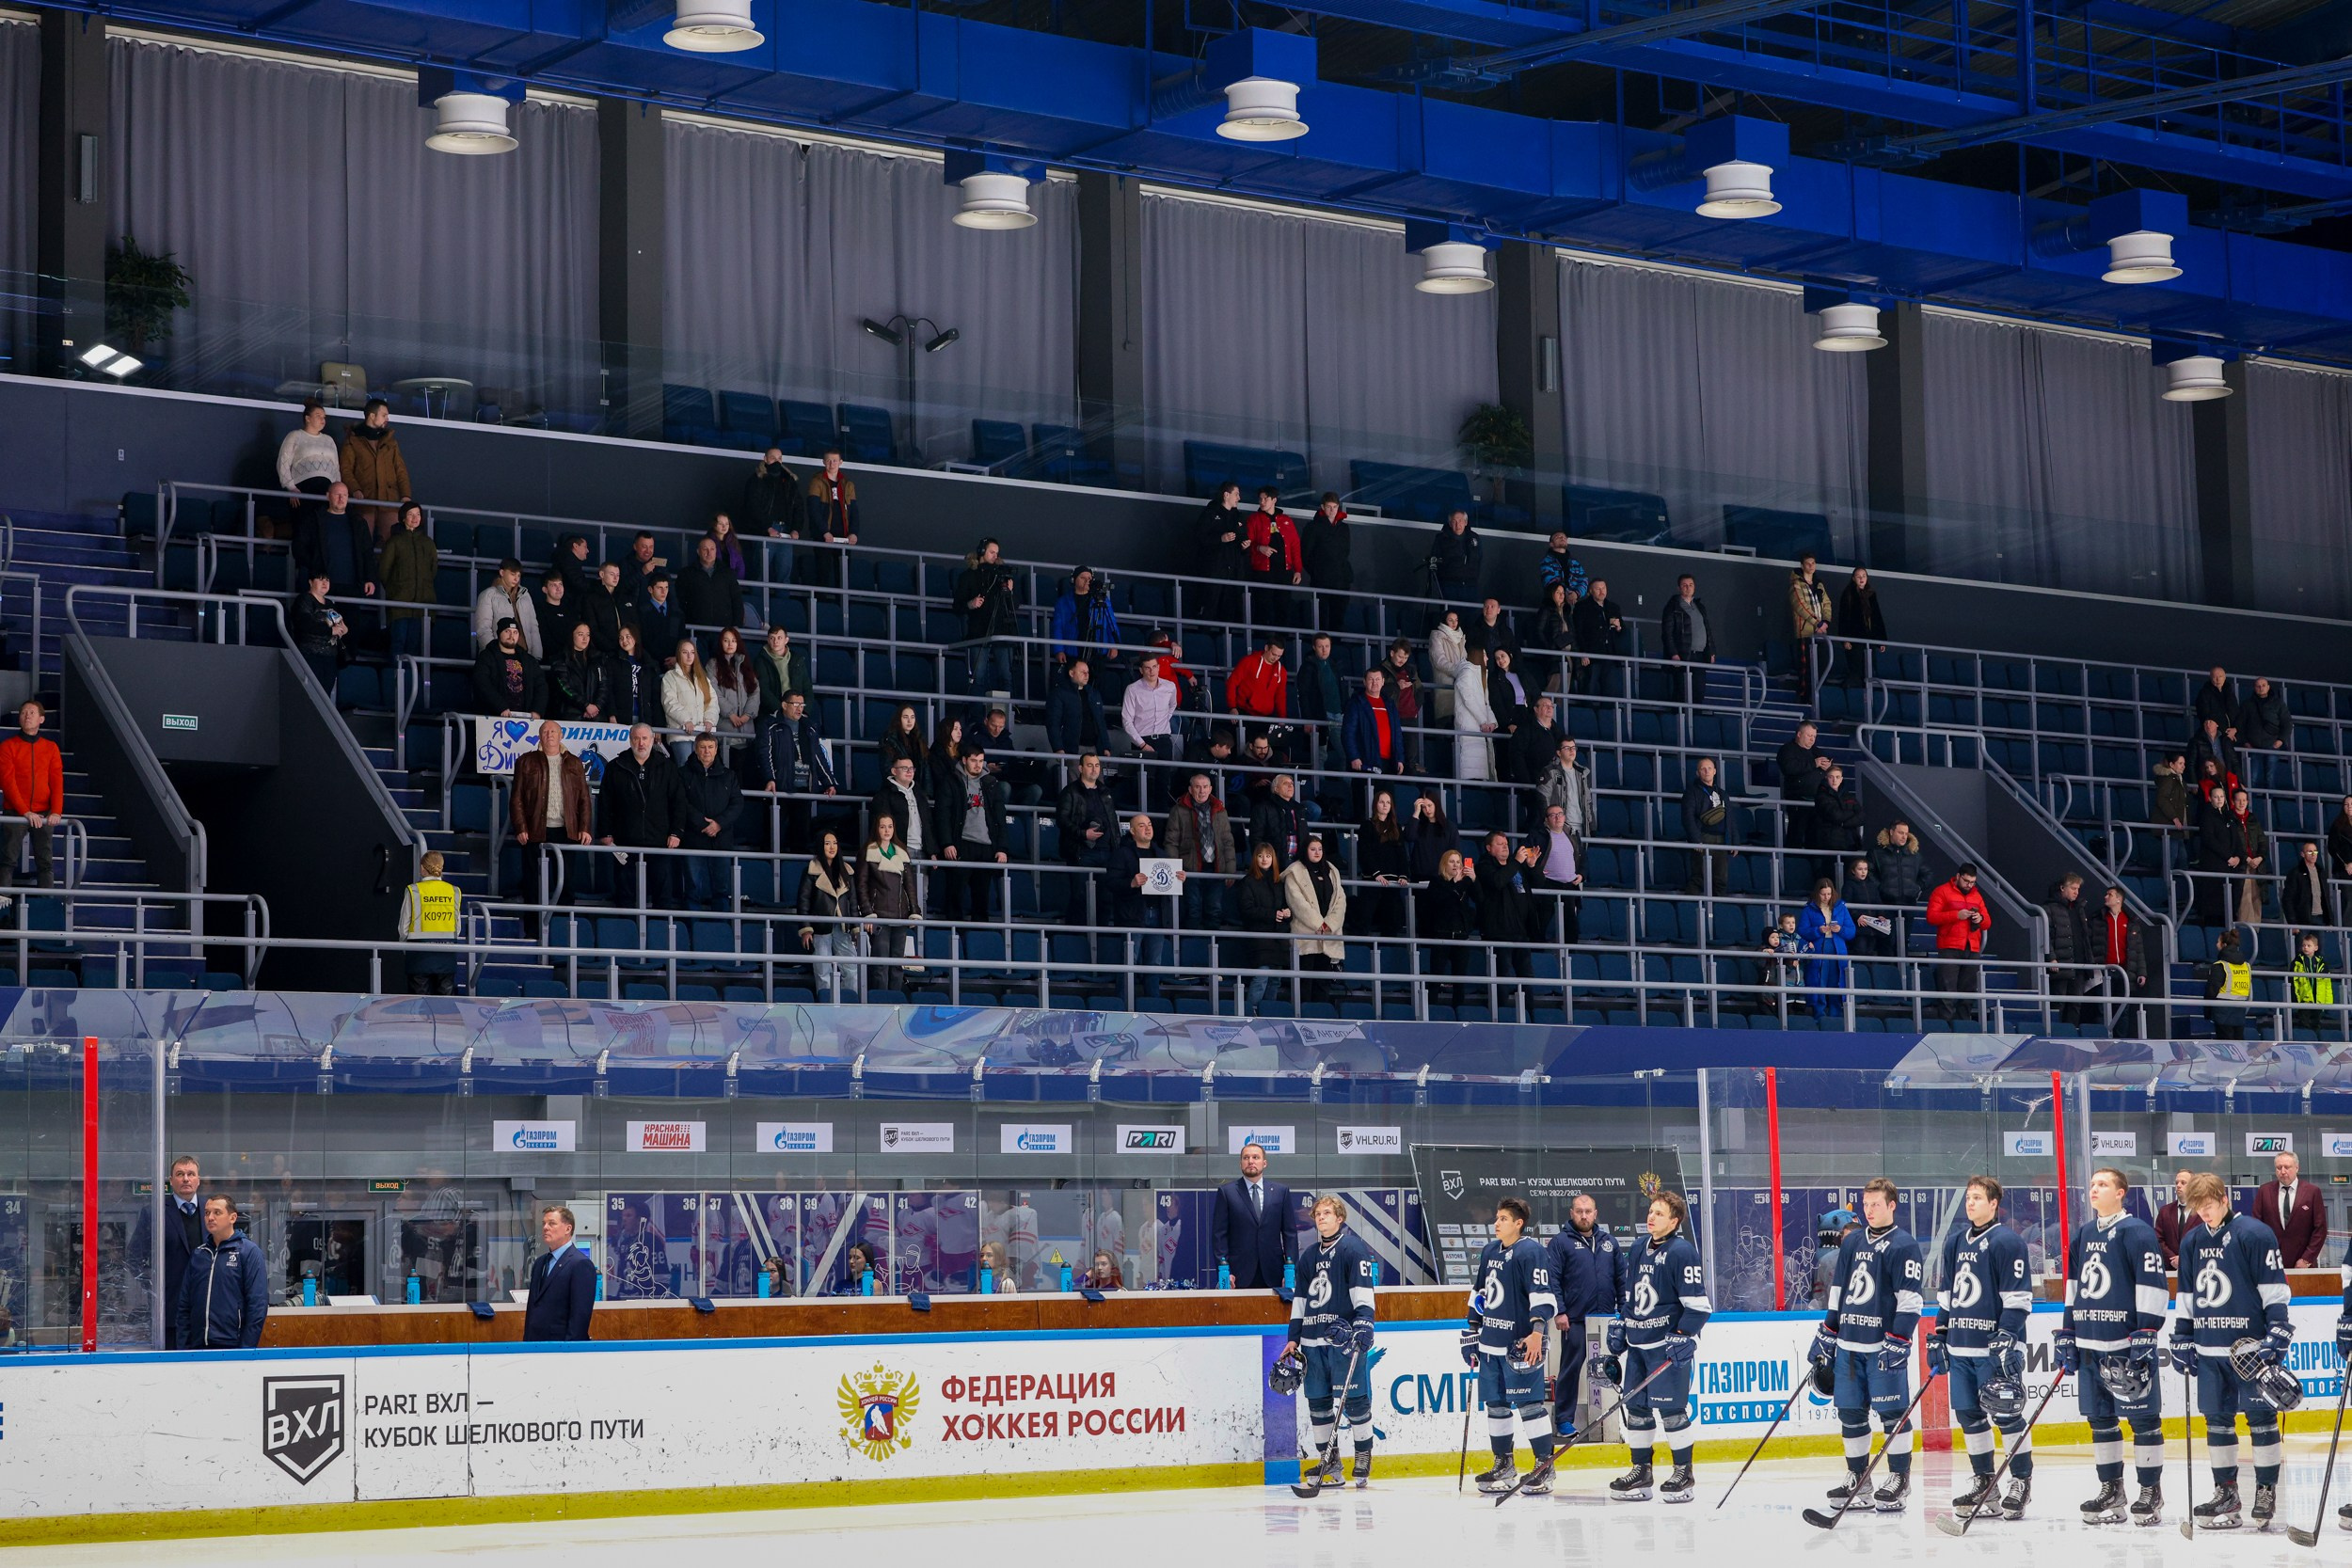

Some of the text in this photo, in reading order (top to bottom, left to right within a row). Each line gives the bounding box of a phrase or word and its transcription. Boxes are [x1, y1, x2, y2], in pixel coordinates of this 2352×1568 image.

[166, 718, 196, 728] ВЫХОД
[492, 721, 503, 739] Я
[424, 911, 453, 922] K0977
[644, 1124, 680, 1132] КРАСНАЯ
[526, 1131, 557, 1140] ГАЗПРОМ
[643, 1133, 691, 1147] МАШИНА
[787, 1132, 816, 1141] ГАЗПРОМ
[1028, 1133, 1056, 1142] ГАЗПРОМ
[1127, 1132, 1174, 1147] PARI
[1255, 1135, 1280, 1144] ГАЗПРОМ
[1356, 1135, 1398, 1146] VHLRU.RU
[2100, 1139, 2134, 1148] VHLRU.RU
[2252, 1139, 2286, 1151] PARI
[1442, 1176, 1464, 1192] ВХЛ
[1479, 1178, 1499, 1186] PARI
[1501, 1178, 1518, 1186] ВХЛ
[1553, 1178, 1604, 1187] ШЕЛКОВОГО
[1605, 1178, 1626, 1186] ПУТИ
[1159, 1195, 1172, 1207] 43
[1384, 1194, 1396, 1206] 48
[1406, 1194, 1419, 1206] 49
[1687, 1193, 1698, 1205] 56
[1827, 1192, 1837, 1203] 60
[1849, 1192, 1858, 1203] 61
[1899, 1192, 1909, 1203] 62
[1916, 1192, 1927, 1203] 63
[2029, 1192, 2040, 1202] 66
[2045, 1192, 2053, 1202] 67
[2155, 1190, 2164, 1201] 70
[2233, 1191, 2241, 1201] 73
[5, 1200, 21, 1215] 34
[612, 1197, 625, 1210] 35
[682, 1197, 696, 1210] 36
[709, 1197, 722, 1210] 37
[779, 1197, 793, 1210] 38
[804, 1197, 818, 1211] 39
[872, 1197, 885, 1210] 40
[898, 1197, 909, 1210] 41
[963, 1196, 977, 1209] 42
[1301, 1196, 1313, 1208] 46
[2085, 1242, 2107, 1254] МХК
[2200, 1247, 2224, 1259] МХК
[1855, 1251, 1874, 1262] МХК
[1957, 1252, 1979, 1263] МХК
[1359, 1259, 1373, 1277] 67
[1486, 1259, 1505, 1271] МХК
[2013, 1259, 2025, 1279] 9
[2143, 1252, 2164, 1274] 22
[1683, 1266, 1702, 1284] 95
[1904, 1259, 1922, 1281] 86
[1533, 1267, 1549, 1287] 50
[1699, 1360, 1789, 1394] ГАЗПРОМ
[941, 1372, 1116, 1407] ФЕДЕРАЦИЯ
[364, 1394, 417, 1416] PARI
[426, 1393, 469, 1414] ВХЛ
[267, 1400, 340, 1451] ВХЛ
[942, 1407, 1185, 1441] ХОККЕЯ РОССИИ
[364, 1418, 644, 1449] КУБОК ШЕЛКОВОГО ПУТИ
